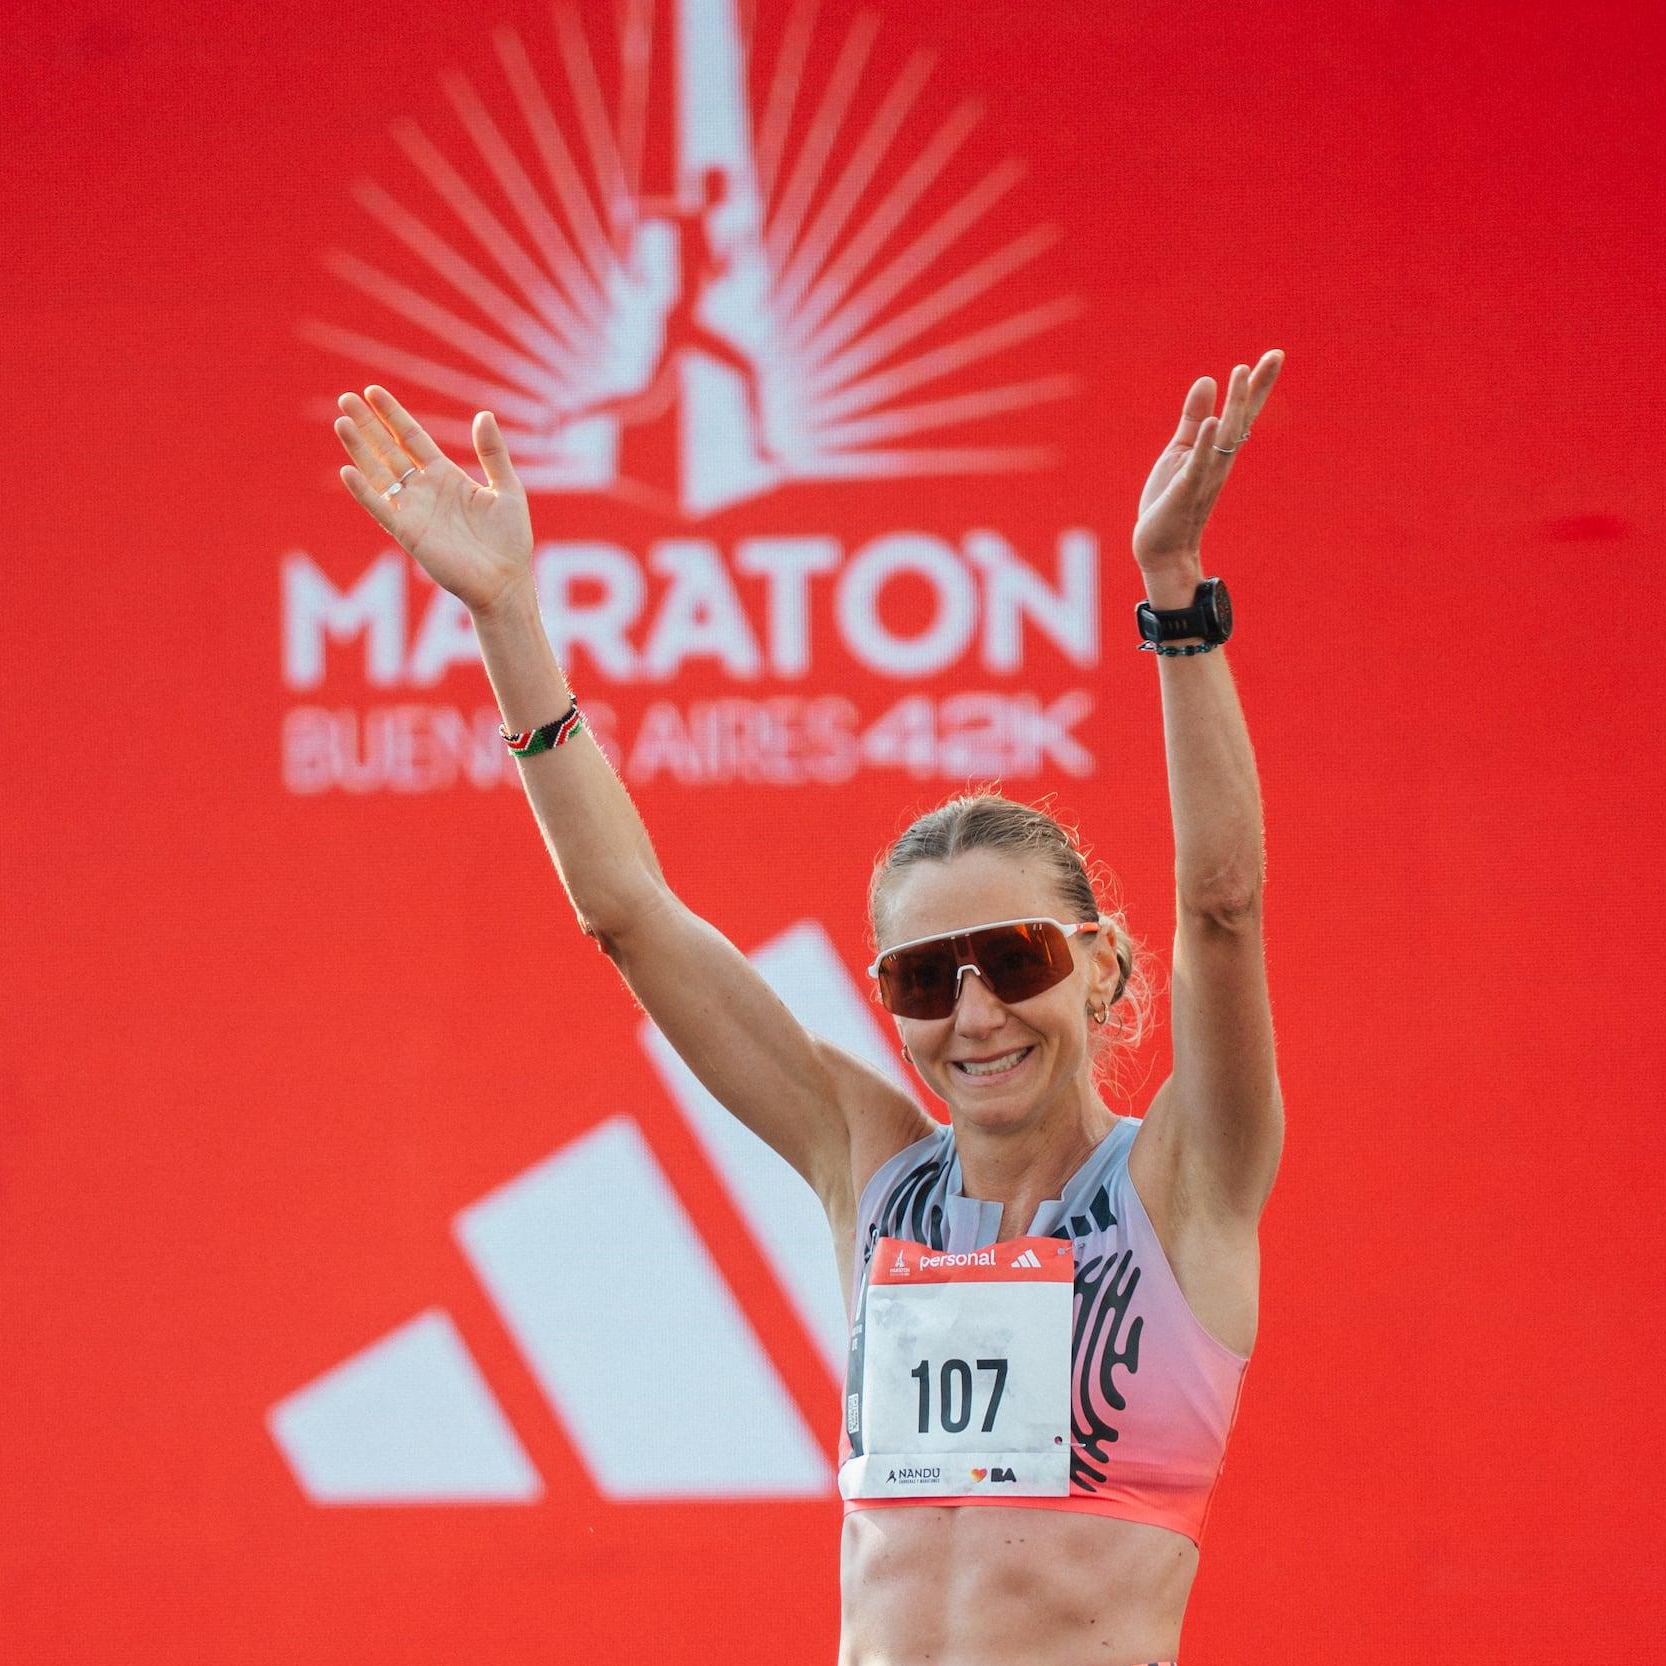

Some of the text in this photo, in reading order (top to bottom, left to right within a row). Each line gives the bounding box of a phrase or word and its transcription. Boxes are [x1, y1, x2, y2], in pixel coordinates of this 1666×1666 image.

[919, 1249, 997, 1271] personal
[911, 1359, 1008, 1433] 107
[991, 1468, 1017, 1482] BA
